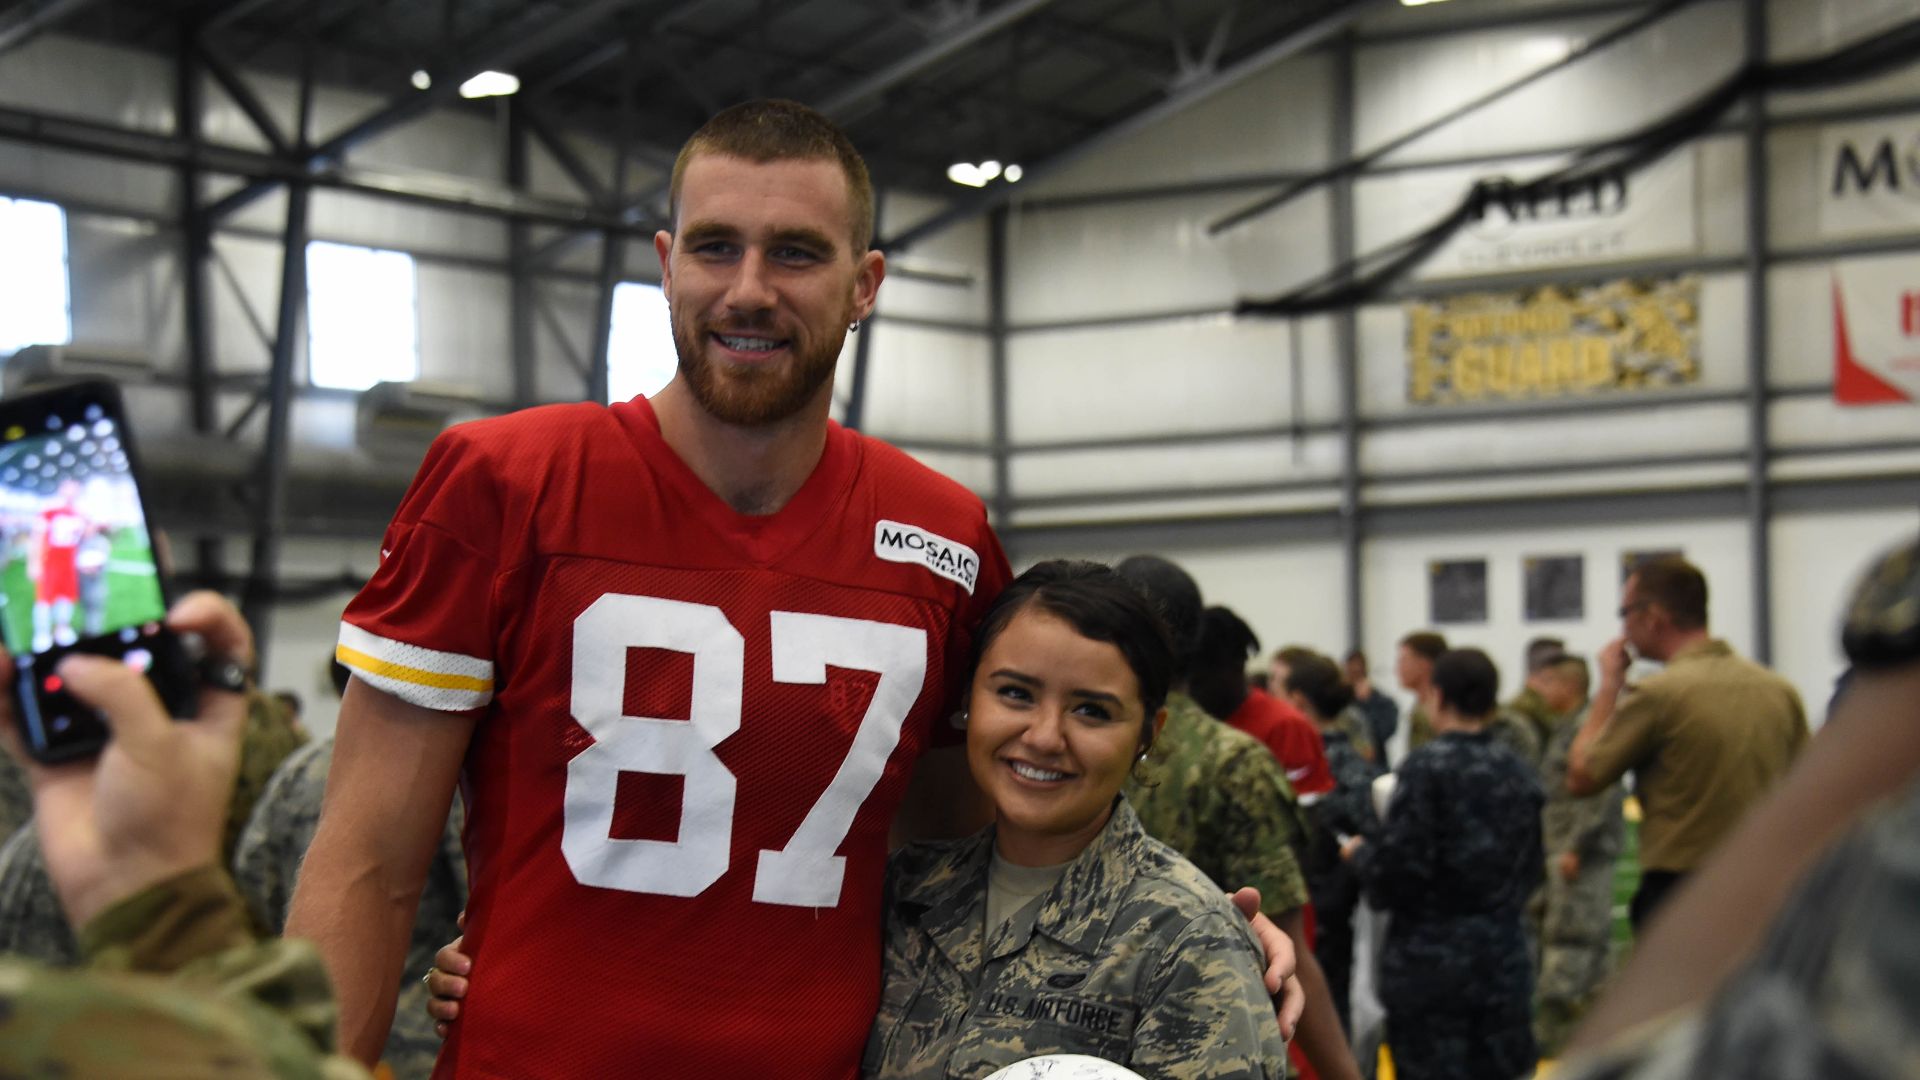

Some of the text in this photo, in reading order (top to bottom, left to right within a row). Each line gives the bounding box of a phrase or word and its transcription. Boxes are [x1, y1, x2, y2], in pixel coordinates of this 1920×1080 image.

[880, 528, 976, 577] MOSAIC
[561, 592, 927, 908] 87
[987, 993, 1122, 1034] U.S. AIR FORCE
